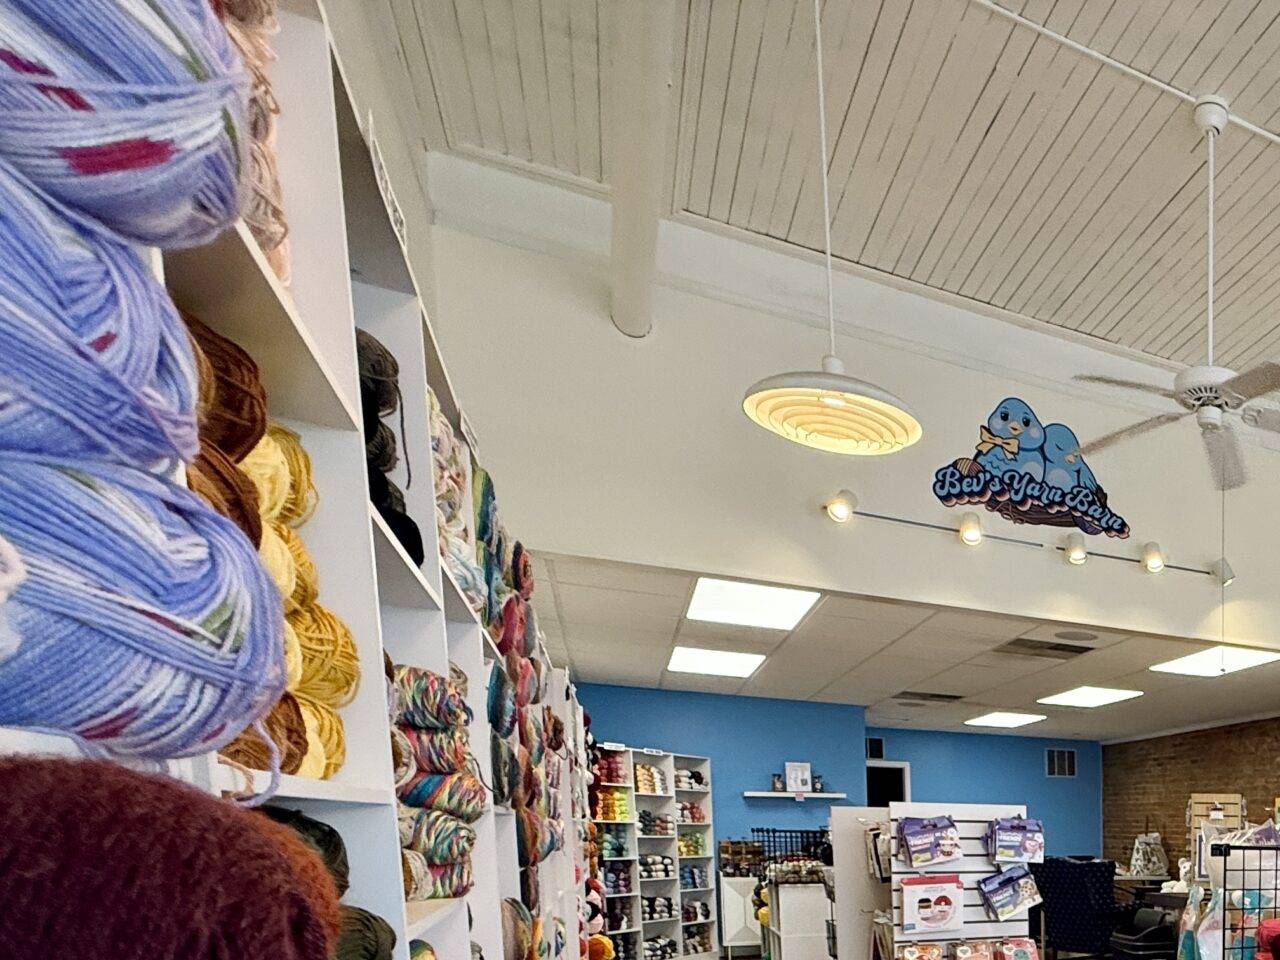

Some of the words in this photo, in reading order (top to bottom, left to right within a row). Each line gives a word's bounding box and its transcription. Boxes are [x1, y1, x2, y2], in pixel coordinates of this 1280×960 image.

[934, 466, 1001, 497] Bev's
[1003, 470, 1064, 505] Yarn
[1064, 485, 1124, 531] Barn
